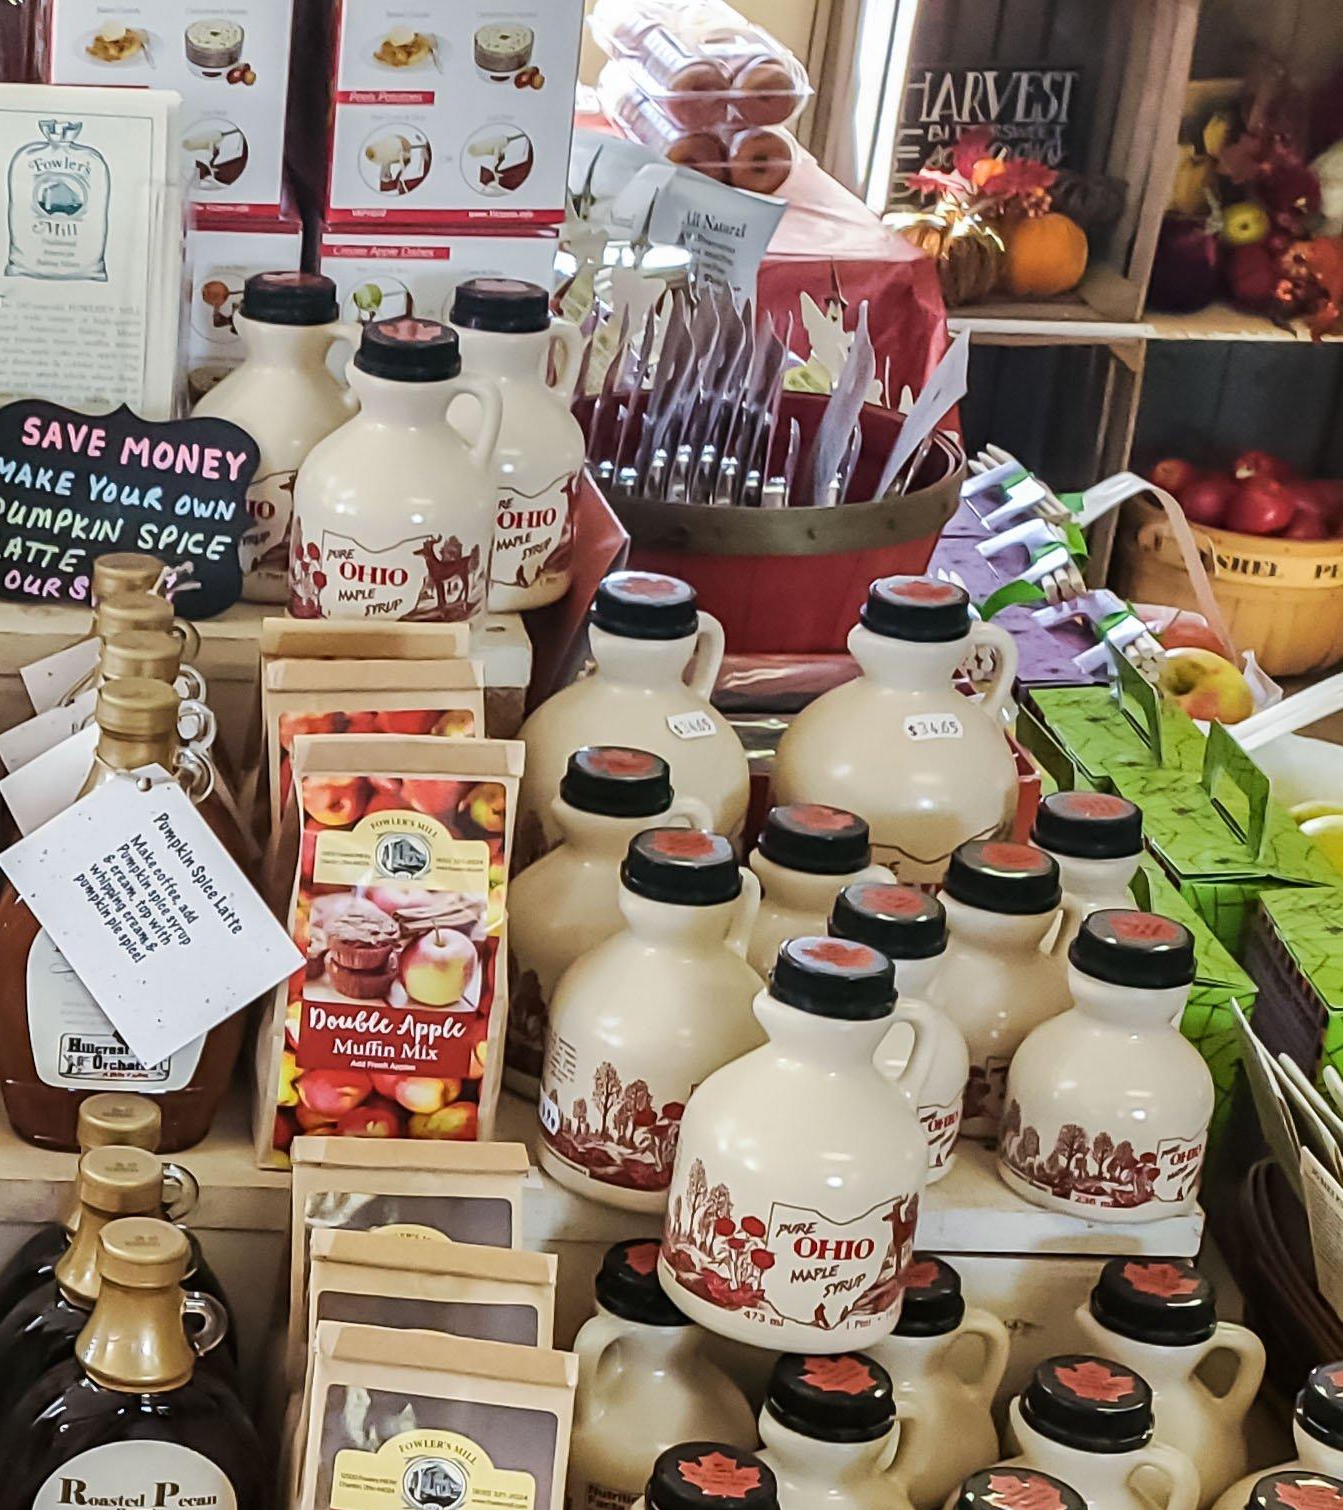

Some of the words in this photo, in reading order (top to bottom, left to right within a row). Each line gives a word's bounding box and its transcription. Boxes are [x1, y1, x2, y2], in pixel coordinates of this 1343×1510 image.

[902, 71, 1078, 122] HARVEST
[21, 416, 106, 456] SAVE
[121, 437, 247, 481] MONEY
[89, 474, 163, 511] YOUR
[175, 495, 235, 520] OWN
[496, 507, 557, 530] OHIO
[137, 523, 232, 560] SPICE
[327, 548, 354, 561] PURE
[496, 532, 532, 552] MAPLE
[5, 570, 59, 598] OUR
[339, 562, 408, 587] OHIO
[338, 588, 375, 601] MAPLE
[365, 599, 403, 616] SYRUP
[130, 834, 157, 869] Make
[179, 904, 199, 925] add
[153, 812, 195, 868] Pumpkin
[191, 865, 218, 900] Spice
[214, 896, 243, 935] Latte
[73, 873, 111, 919] pumpkin
[105, 916, 123, 935] pie
[89, 863, 126, 913] whipping
[123, 910, 149, 945] cream
[148, 889, 170, 916] spice
[166, 915, 191, 946] syrup
[136, 900, 151, 919] top
[149, 917, 171, 946] with
[309, 1006, 394, 1036] Double
[398, 1014, 467, 1045] Apple
[333, 1038, 395, 1058] Muffin
[400, 1043, 438, 1062] Mix
[776, 1222, 818, 1237] PURE
[793, 1237, 874, 1260] OHIO
[790, 1266, 840, 1283] MAPLE
[823, 1273, 866, 1298] SYRUP
[58, 1477, 145, 1507] Roasted
[153, 1482, 217, 1508] Pecan
